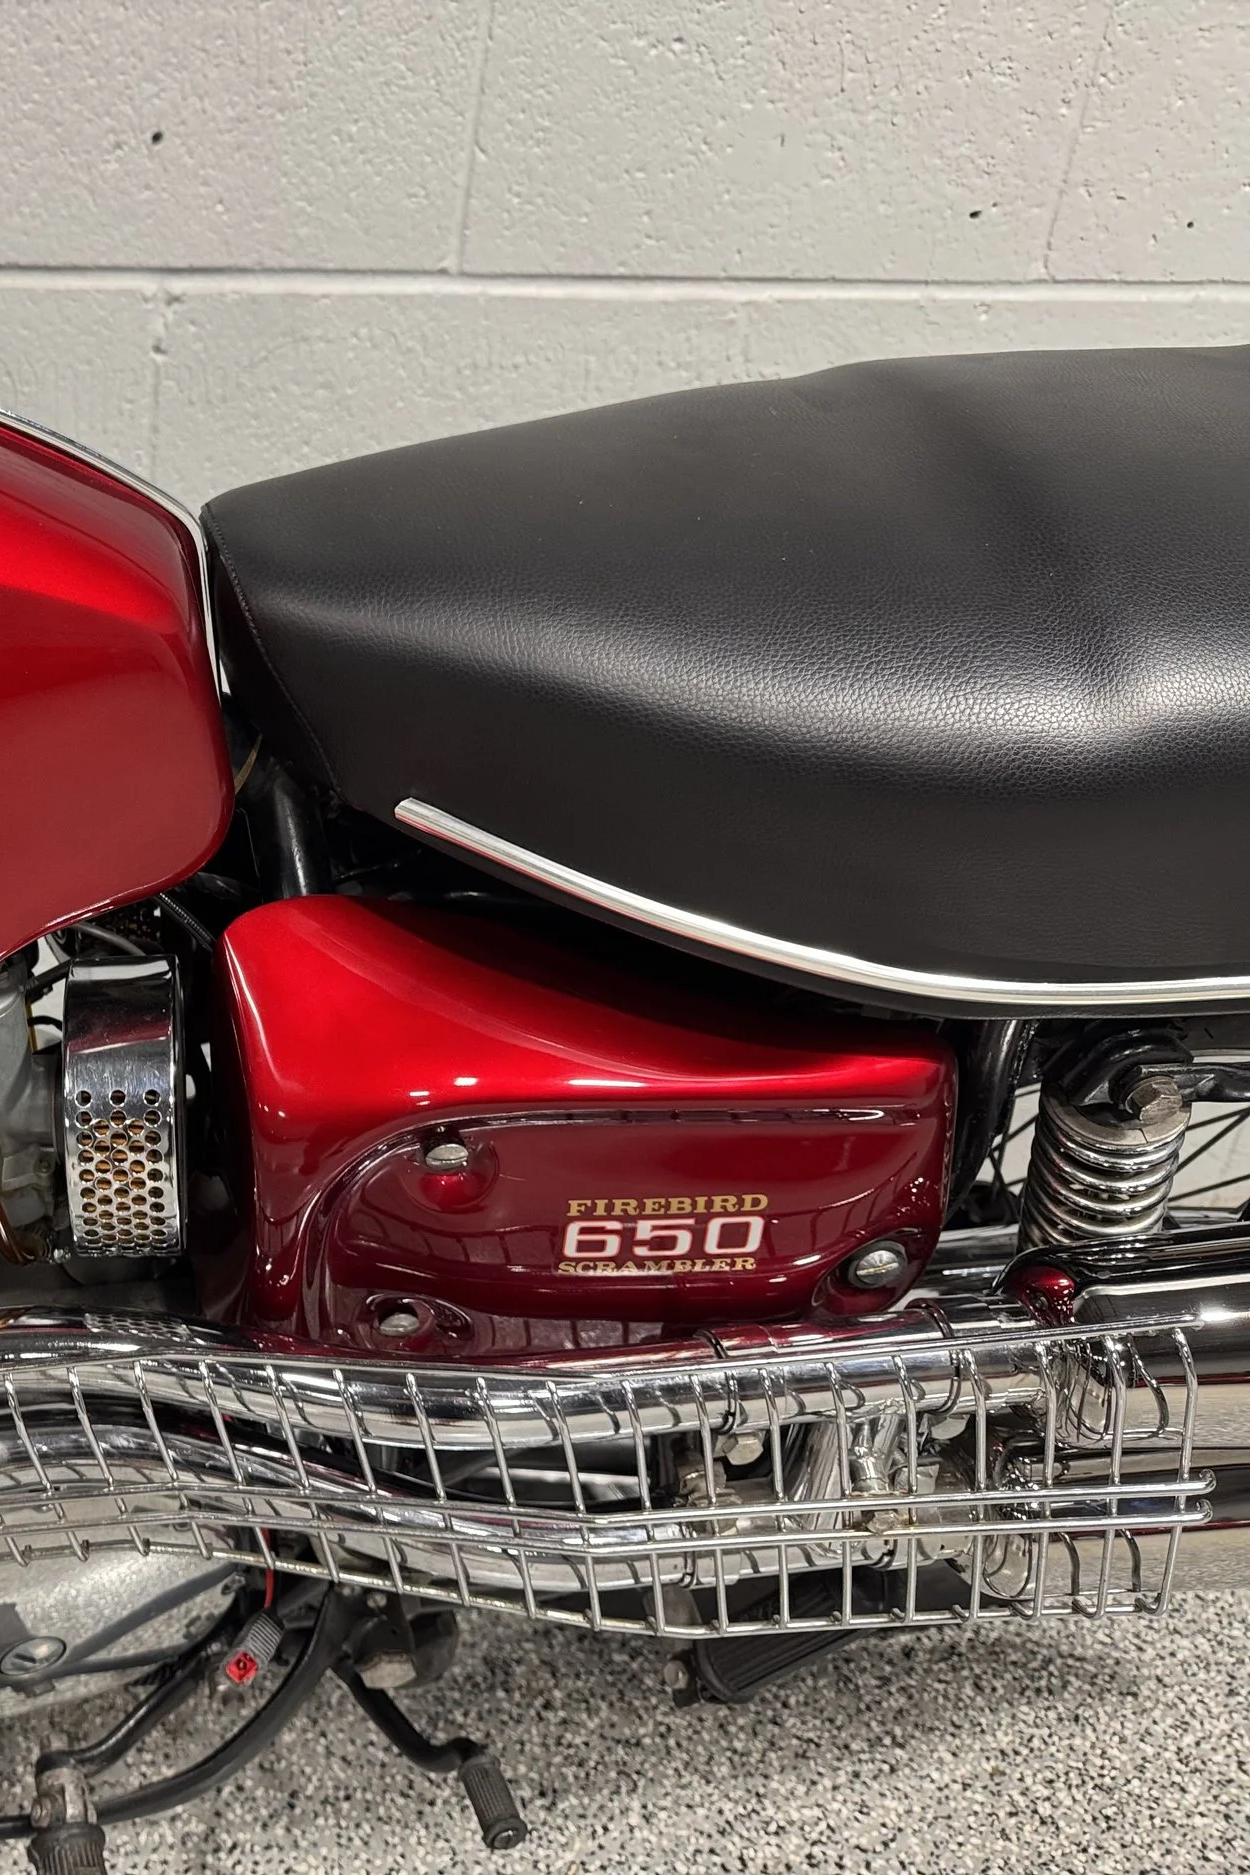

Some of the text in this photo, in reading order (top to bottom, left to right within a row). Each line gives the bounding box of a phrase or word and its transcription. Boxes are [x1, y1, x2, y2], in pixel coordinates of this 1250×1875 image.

[567, 1194, 768, 1216] FIREBIRD
[563, 1215, 764, 1258] 650
[558, 1257, 756, 1274] SCRAMBLER
